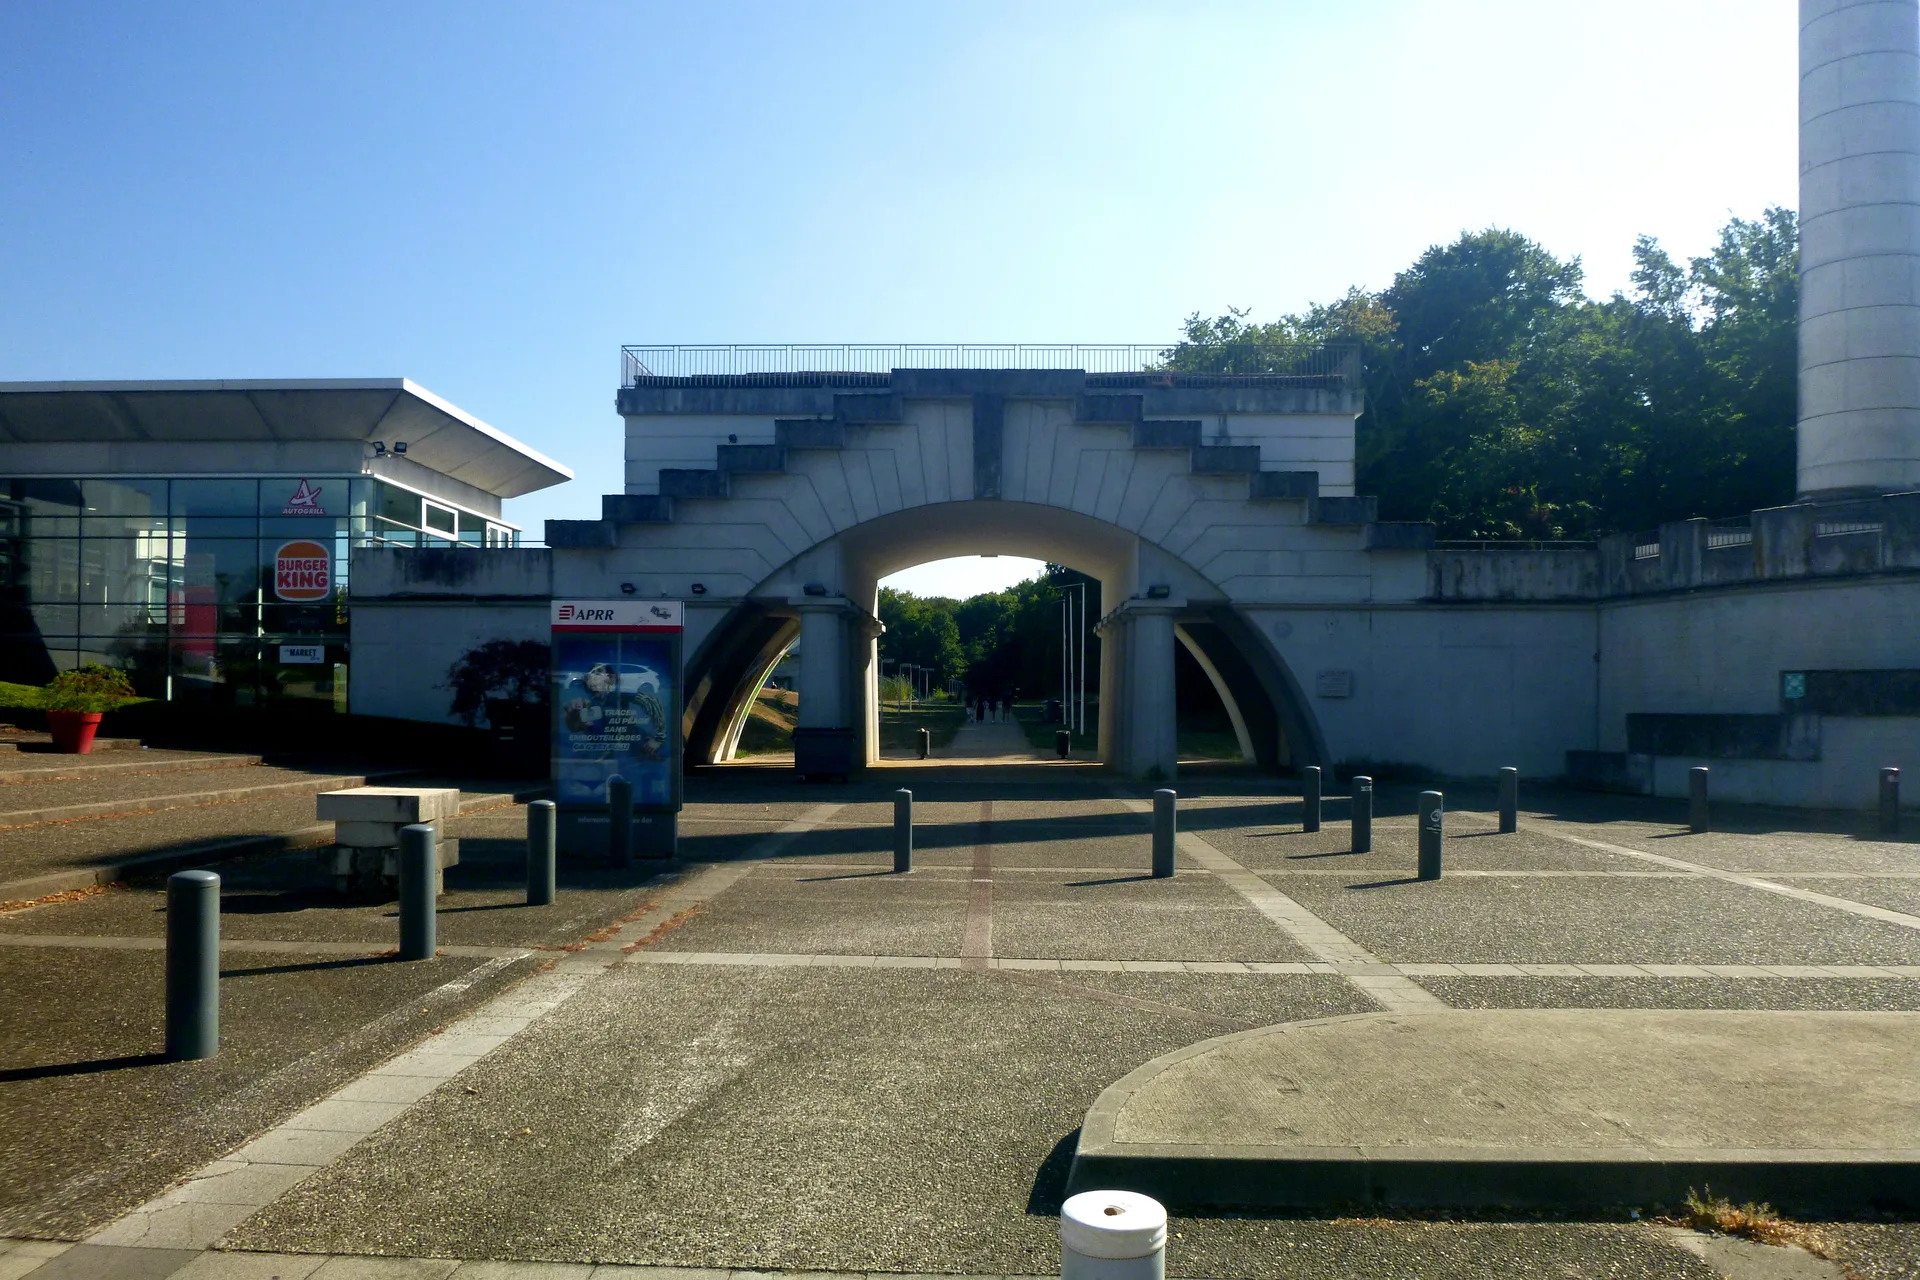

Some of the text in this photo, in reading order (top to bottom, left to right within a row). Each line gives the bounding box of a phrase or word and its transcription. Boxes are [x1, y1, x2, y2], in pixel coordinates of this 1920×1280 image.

[282, 507, 325, 515] AUTOGRILL
[277, 560, 327, 571] BURGER
[277, 572, 327, 588] KING
[575, 609, 614, 621] APRR
[290, 649, 316, 657] MARKET
[608, 717, 621, 725] AU
